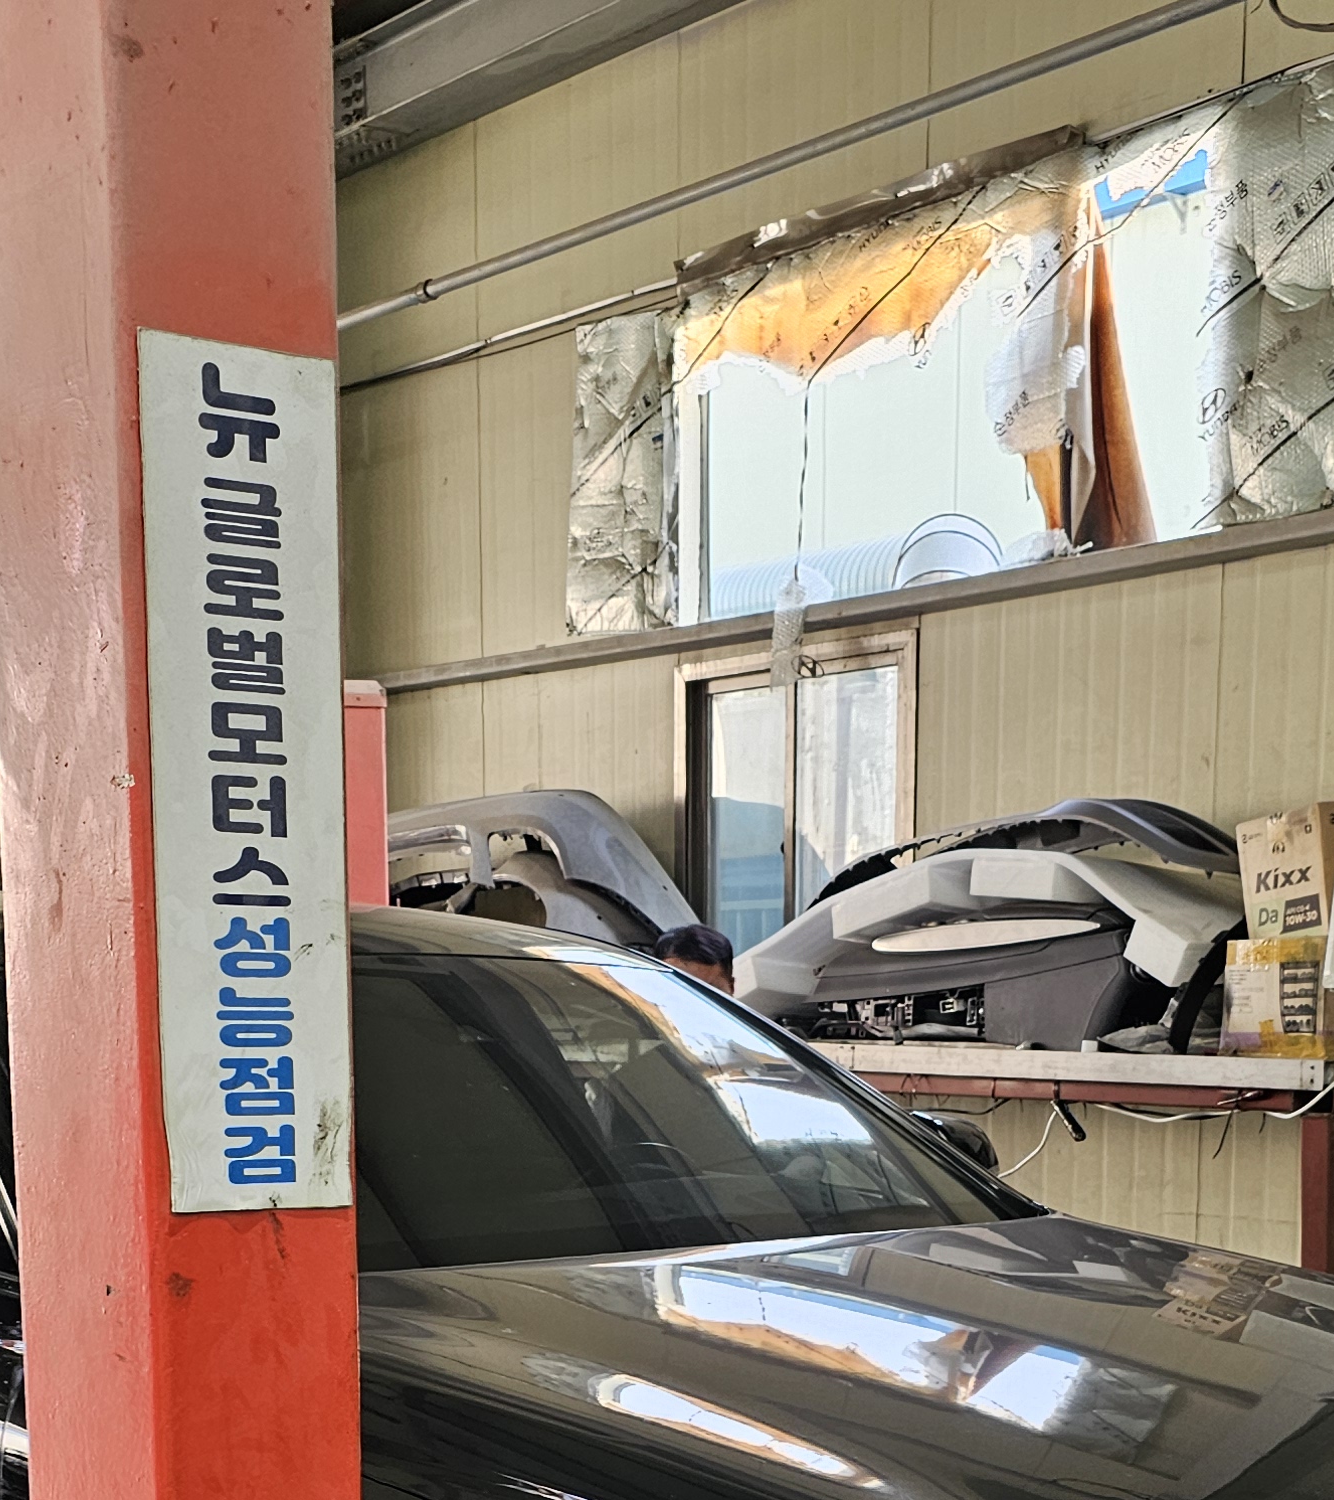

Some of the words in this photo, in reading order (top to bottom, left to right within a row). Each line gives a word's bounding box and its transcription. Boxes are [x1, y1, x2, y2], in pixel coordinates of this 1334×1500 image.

[1255, 865, 1312, 894] Kixx
[1258, 907, 1279, 927] Da
[1284, 910, 1318, 926] 10W-30
[212, 915, 298, 1185] 성능점검
